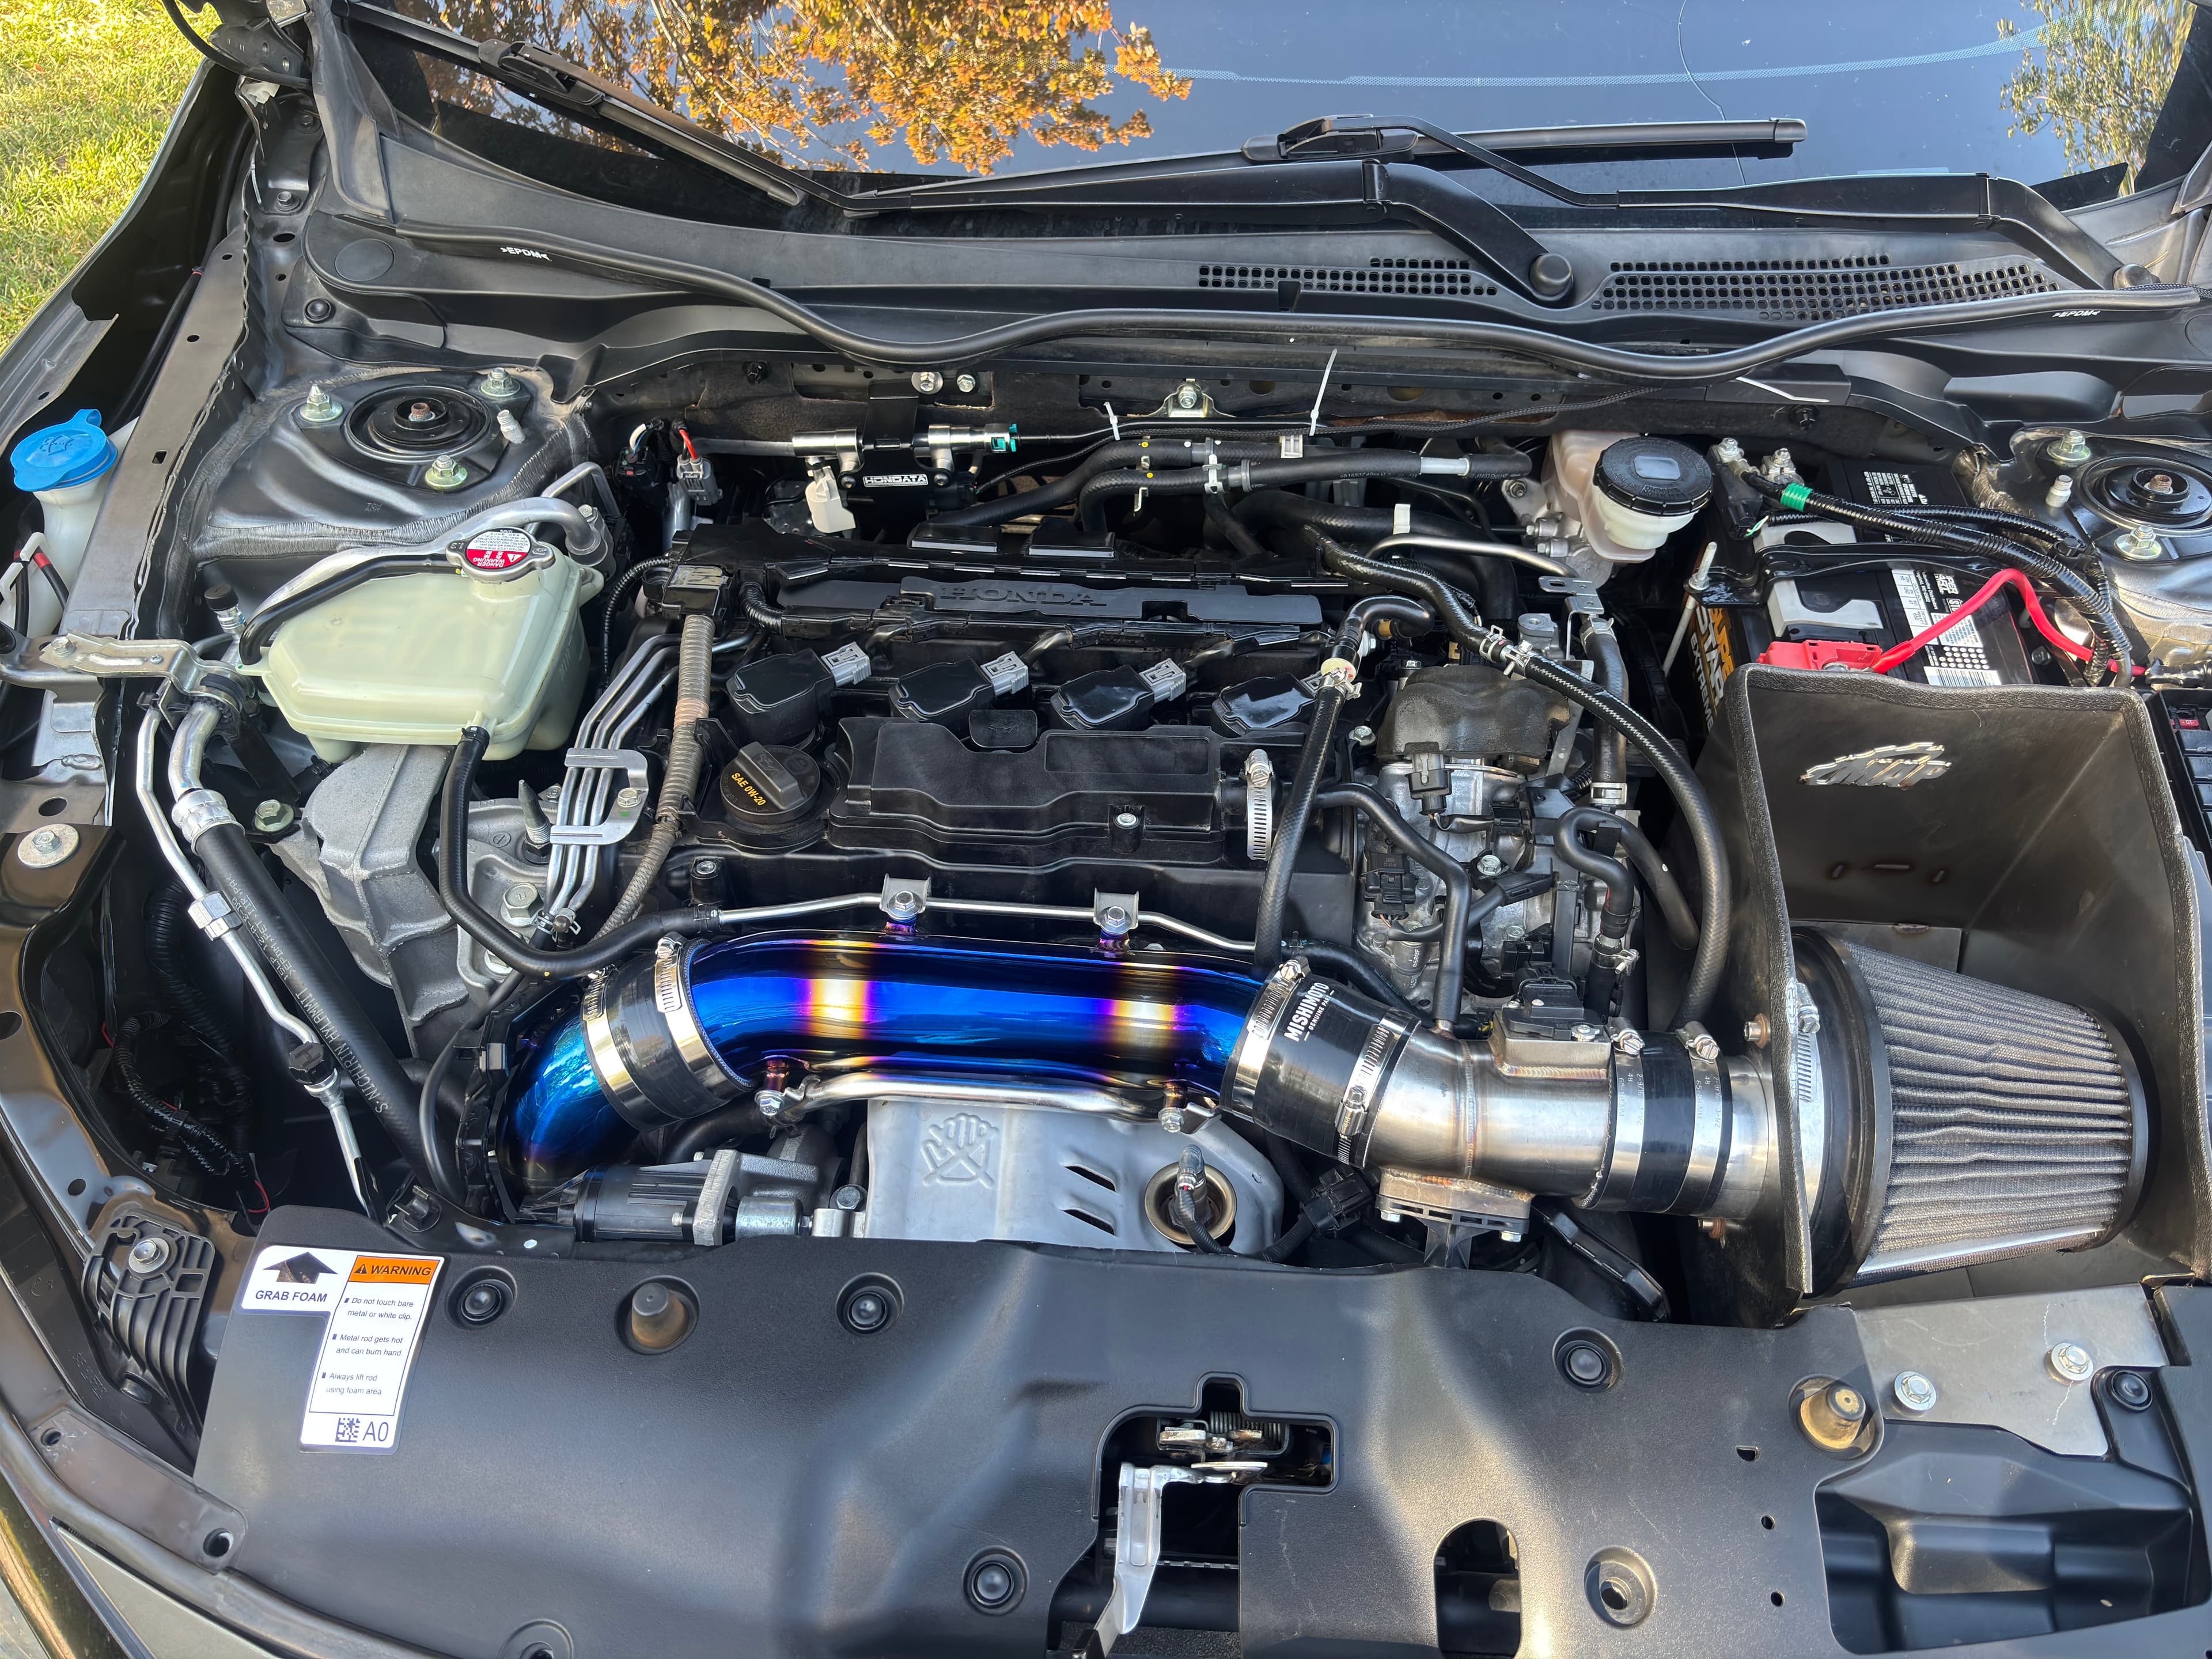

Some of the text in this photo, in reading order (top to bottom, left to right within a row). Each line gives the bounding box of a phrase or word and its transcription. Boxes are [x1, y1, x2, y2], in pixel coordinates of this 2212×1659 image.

[865, 476, 926, 484] HONDATA
[941, 586, 1107, 607] HONDA
[732, 772, 748, 787] SAE
[744, 784, 766, 806] 0W-20
[294, 986, 340, 1043] HYLAMMIT
[1284, 982, 1330, 1042] MISHIMOTO
[1308, 994, 1332, 1031] GENUINE PART
[371, 1265, 431, 1276] WARNING
[255, 1290, 328, 1302] GRAB FOAM
[329, 1373, 354, 1381] Always
[326, 1387, 344, 1395] using
[362, 1421, 389, 1442] A0
